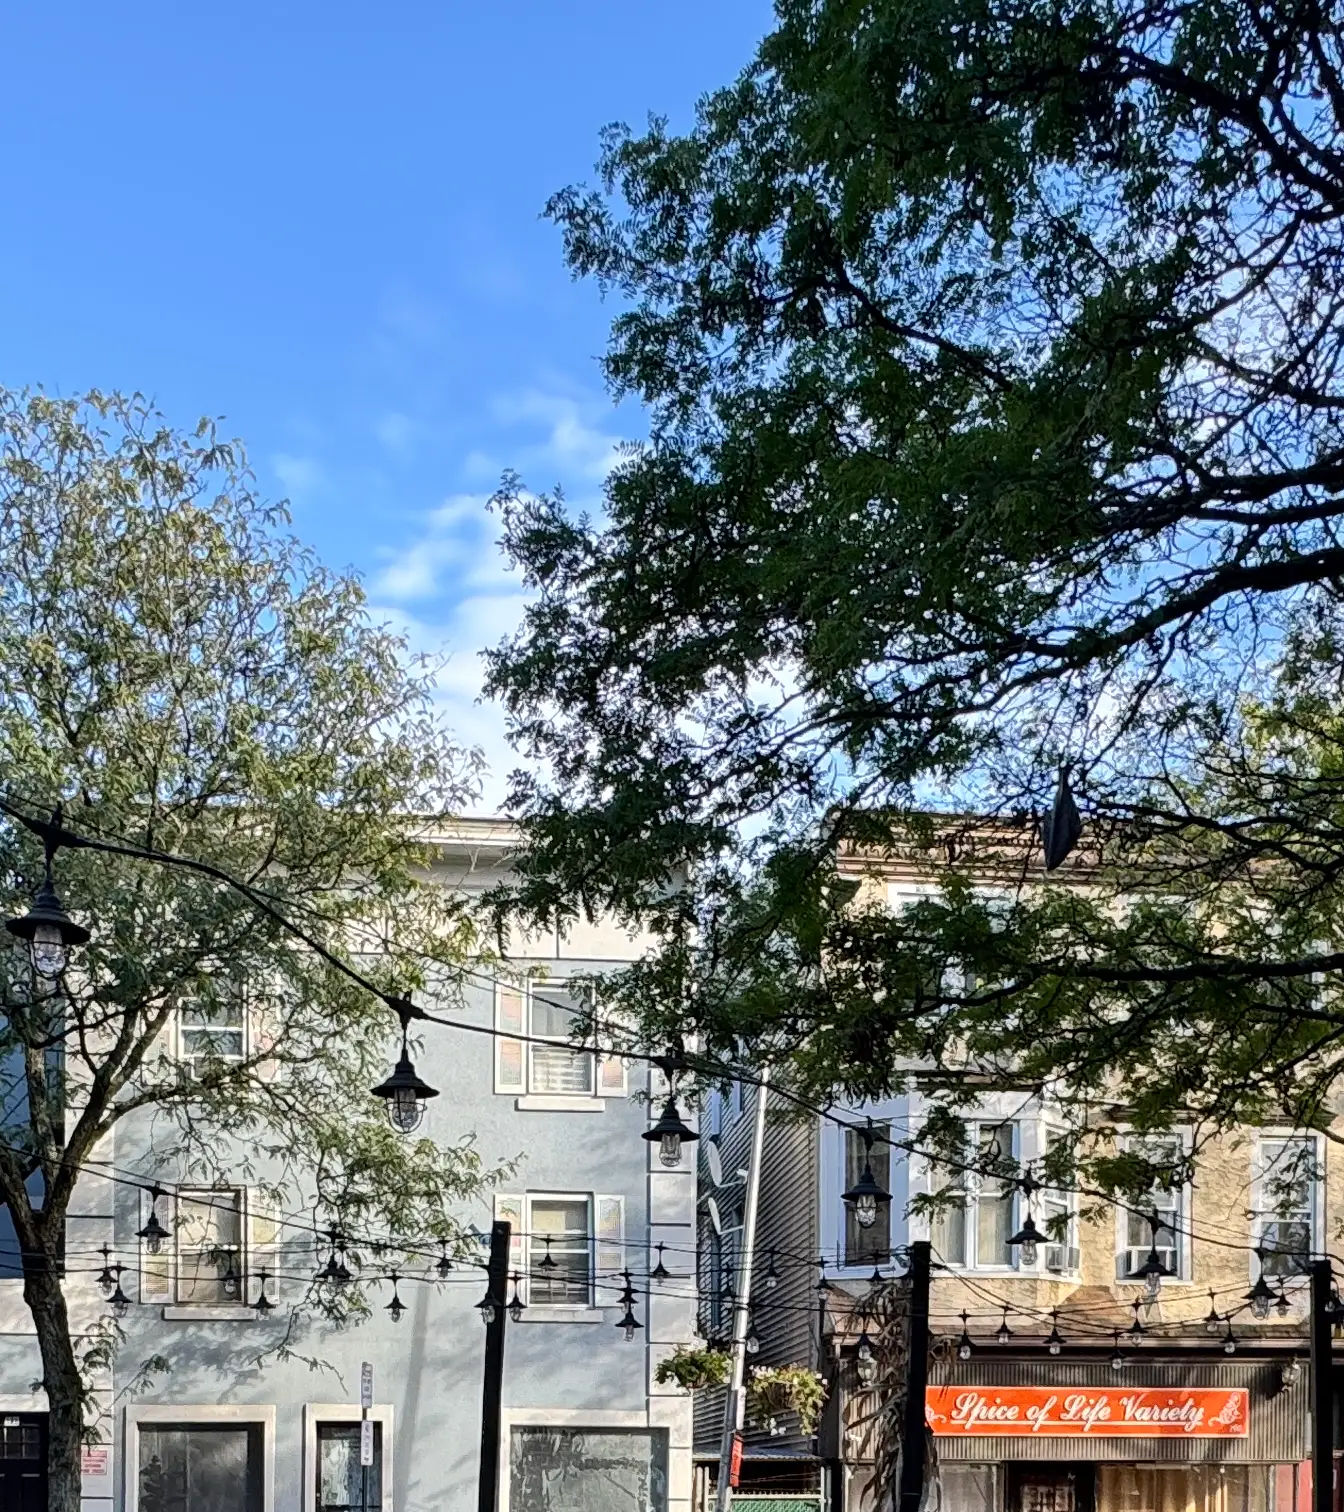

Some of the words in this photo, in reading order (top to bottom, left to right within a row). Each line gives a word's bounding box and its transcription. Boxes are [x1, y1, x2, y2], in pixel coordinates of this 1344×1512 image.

[951, 1392, 1020, 1430] Spice
[1026, 1395, 1058, 1432] of
[1060, 1393, 1111, 1432] Life
[1119, 1392, 1205, 1432] Variety
